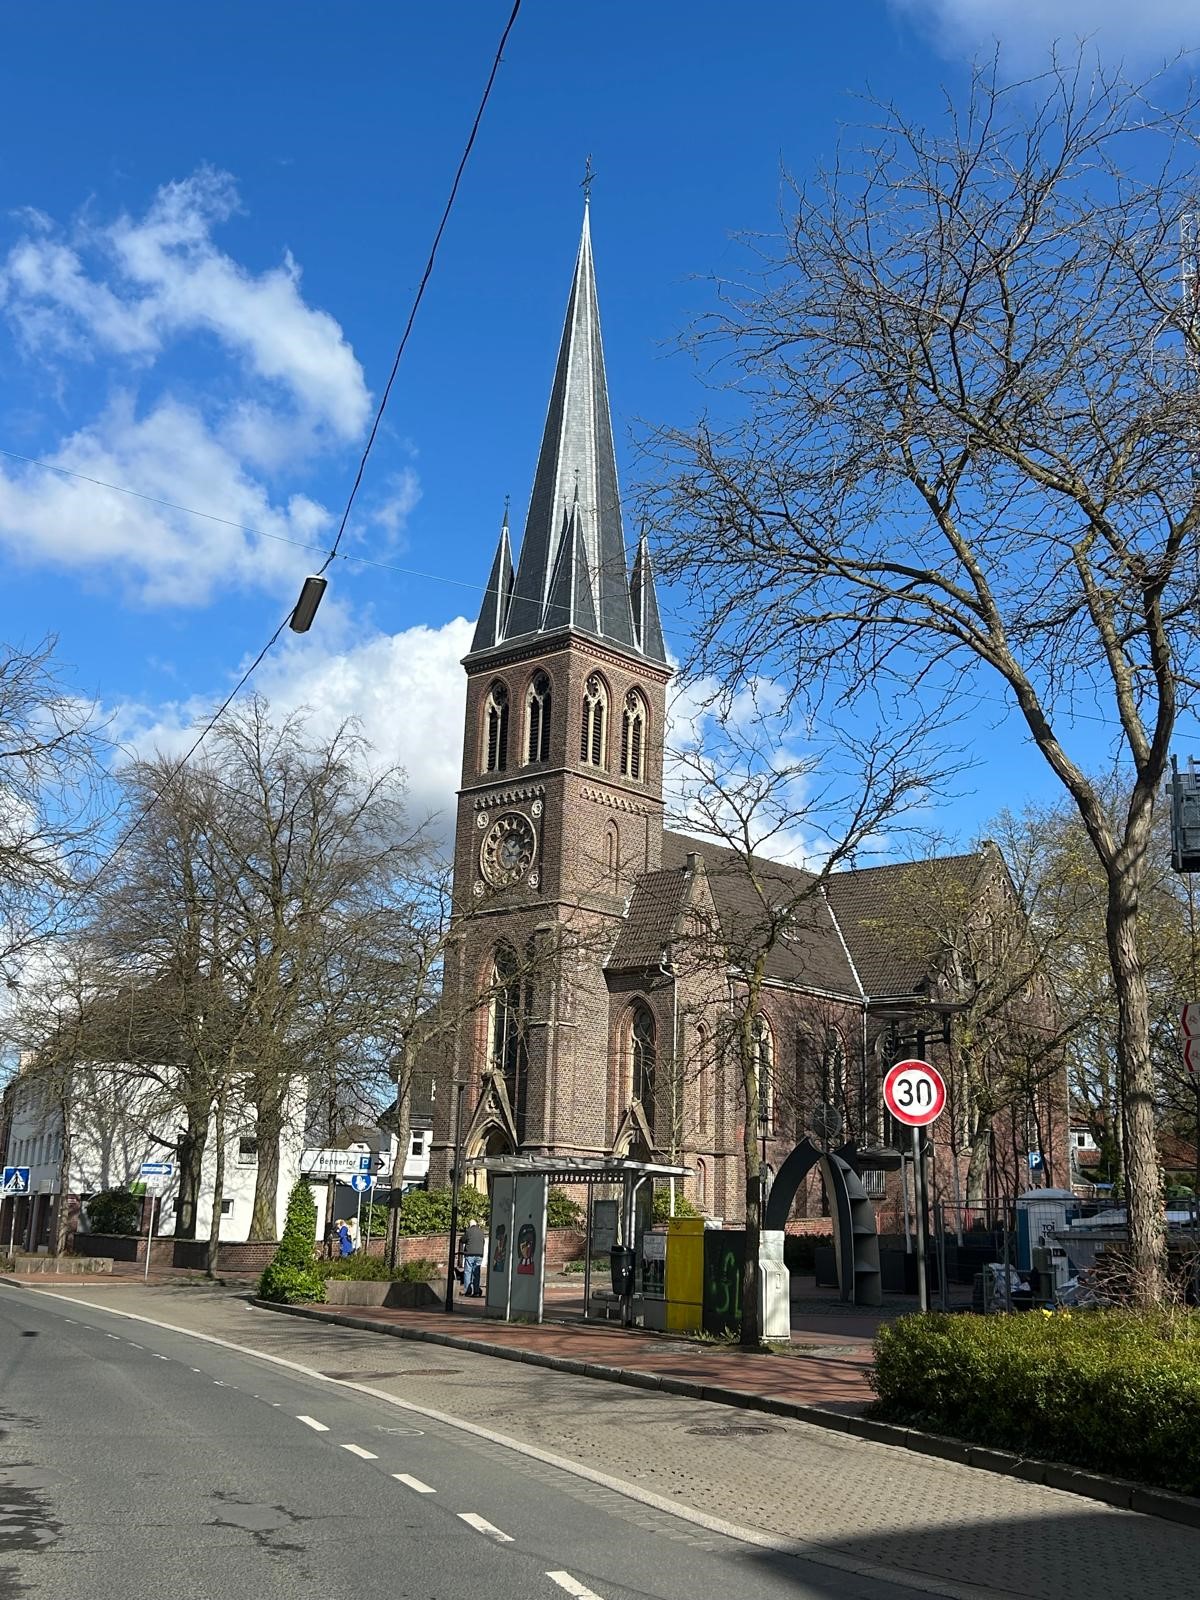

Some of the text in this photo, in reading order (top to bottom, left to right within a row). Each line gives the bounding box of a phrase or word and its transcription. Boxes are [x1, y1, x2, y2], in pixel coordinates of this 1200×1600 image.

[897, 1078, 932, 1107] 30
[361, 1157, 369, 1169] P
[1032, 1154, 1041, 1168] P
